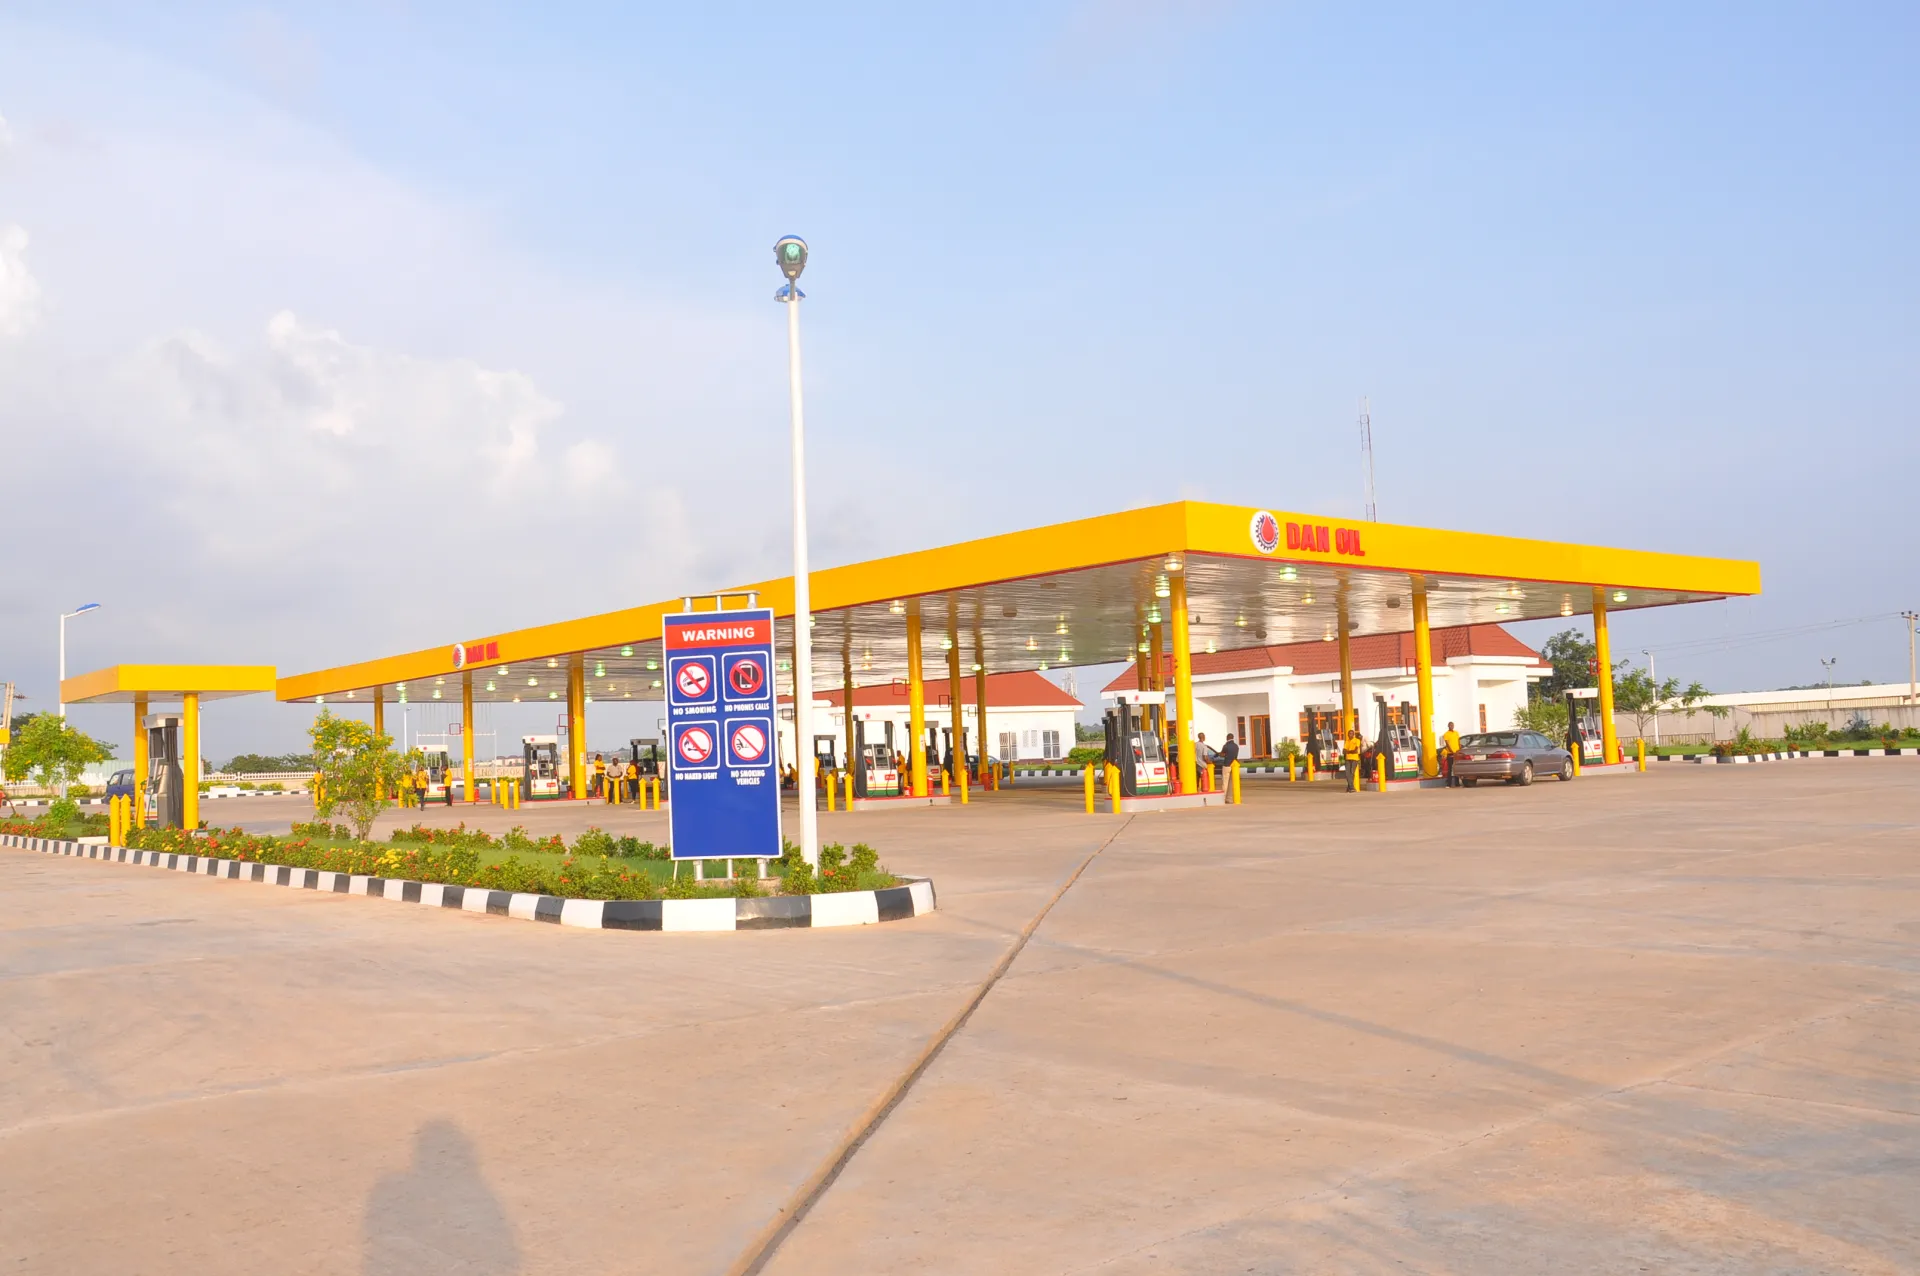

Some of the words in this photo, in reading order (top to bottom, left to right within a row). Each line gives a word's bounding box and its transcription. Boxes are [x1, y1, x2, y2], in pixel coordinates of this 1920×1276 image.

[1286, 522, 1330, 553] DAN
[1335, 527, 1365, 556] OIL
[682, 627, 755, 642] WARNING
[673, 707, 684, 715] NO
[685, 705, 717, 715] SMOKING
[724, 704, 733, 712] NO
[755, 702, 770, 710] CALLS
[675, 772, 684, 780] NO
[731, 770, 740, 778] NO
